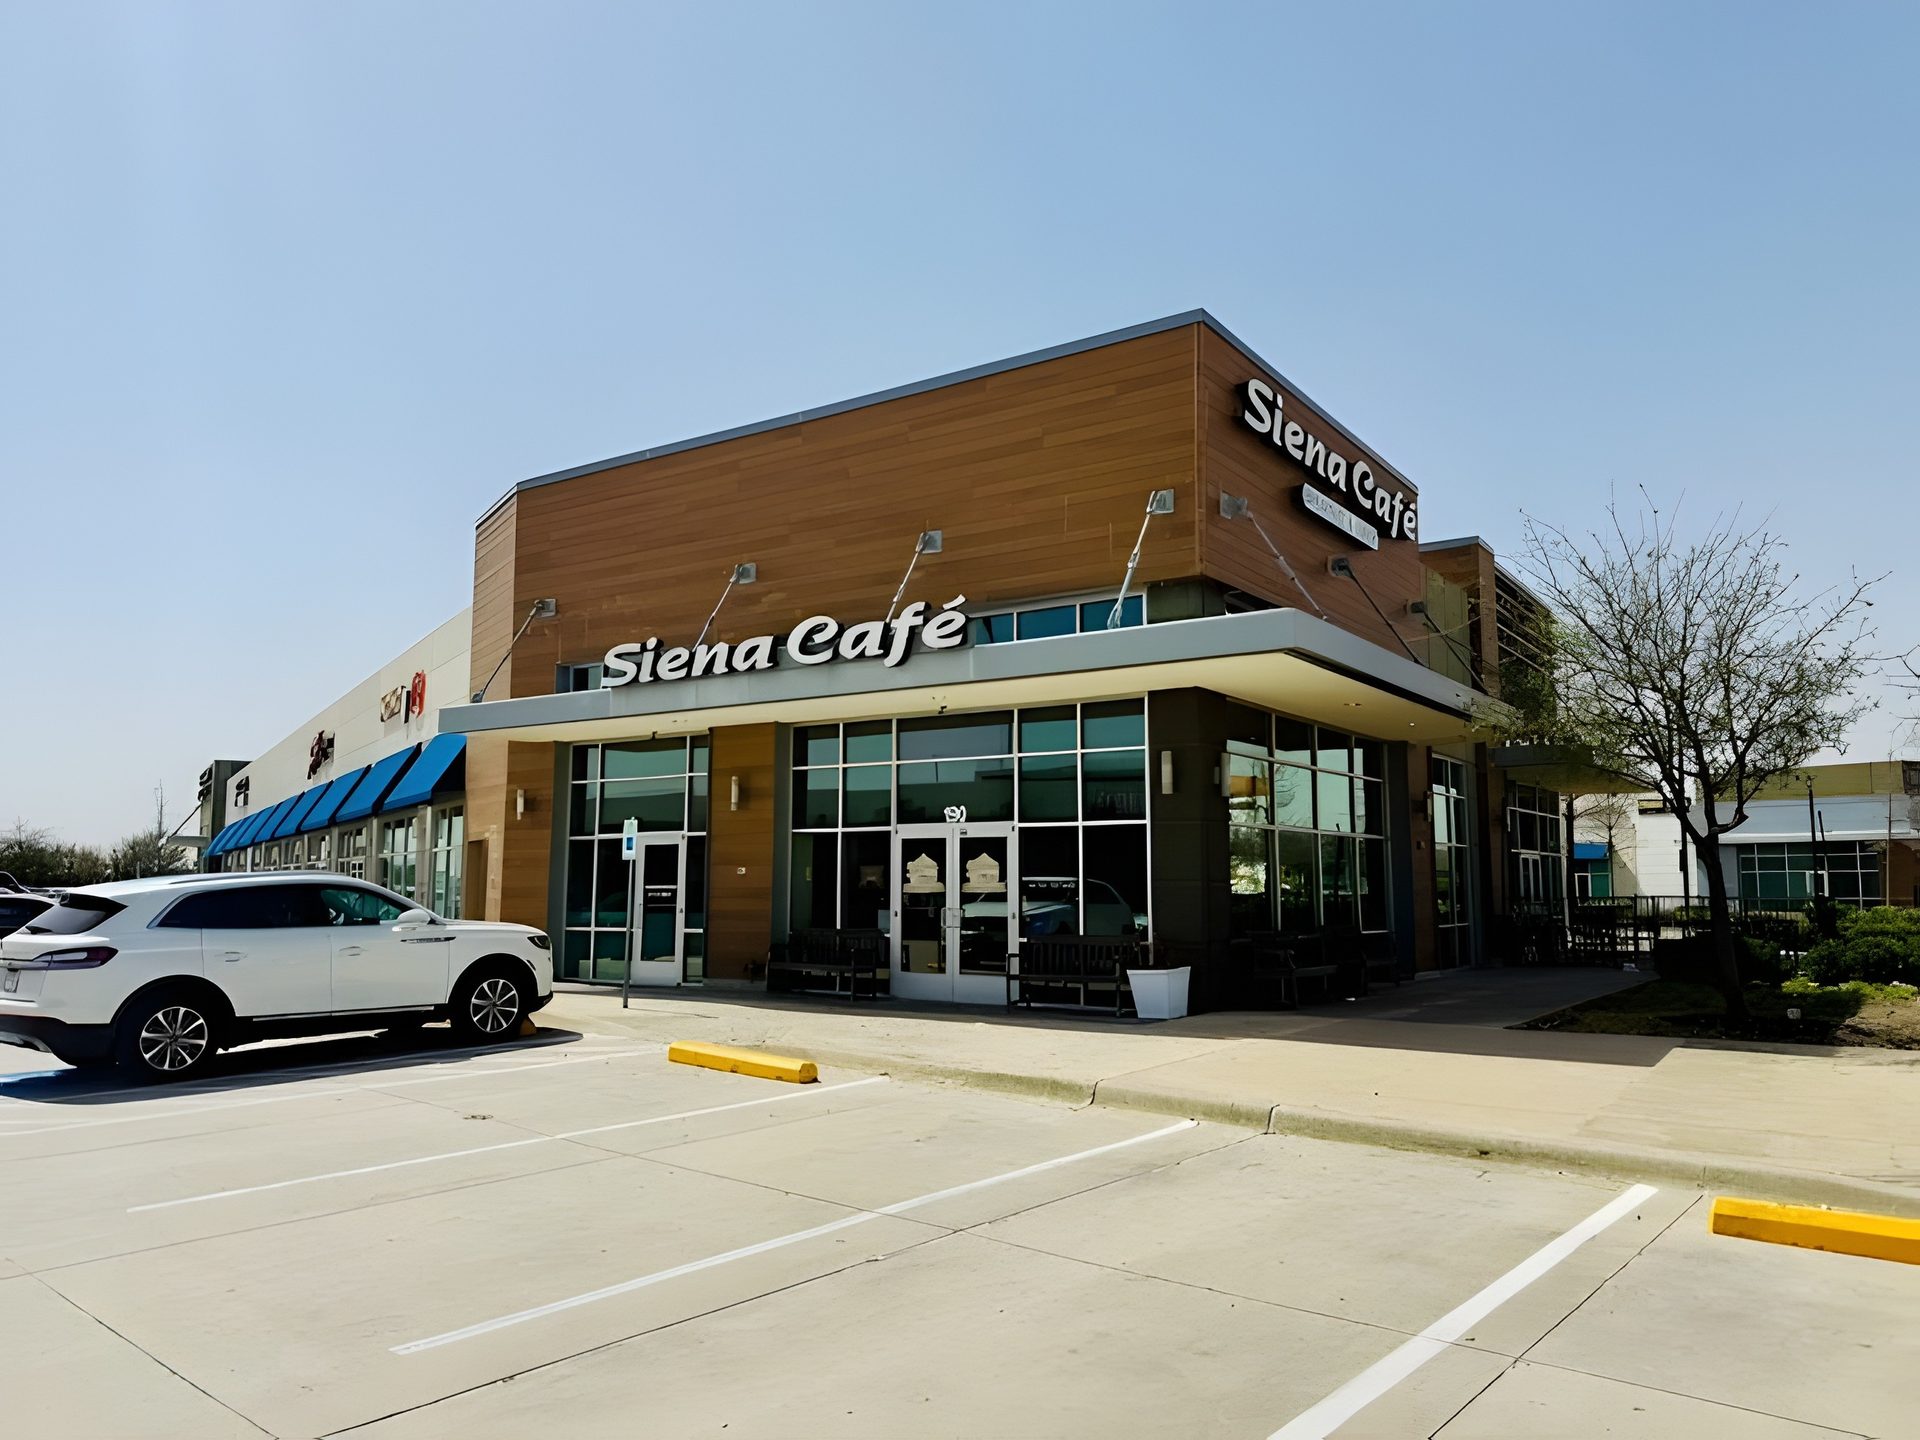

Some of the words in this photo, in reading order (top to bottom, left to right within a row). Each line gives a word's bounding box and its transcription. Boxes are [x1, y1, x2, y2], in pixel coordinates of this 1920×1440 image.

[1244, 378, 1347, 492] Siena
[1352, 460, 1416, 541] Café
[601, 636, 775, 688] Siena
[786, 594, 967, 668] Café
